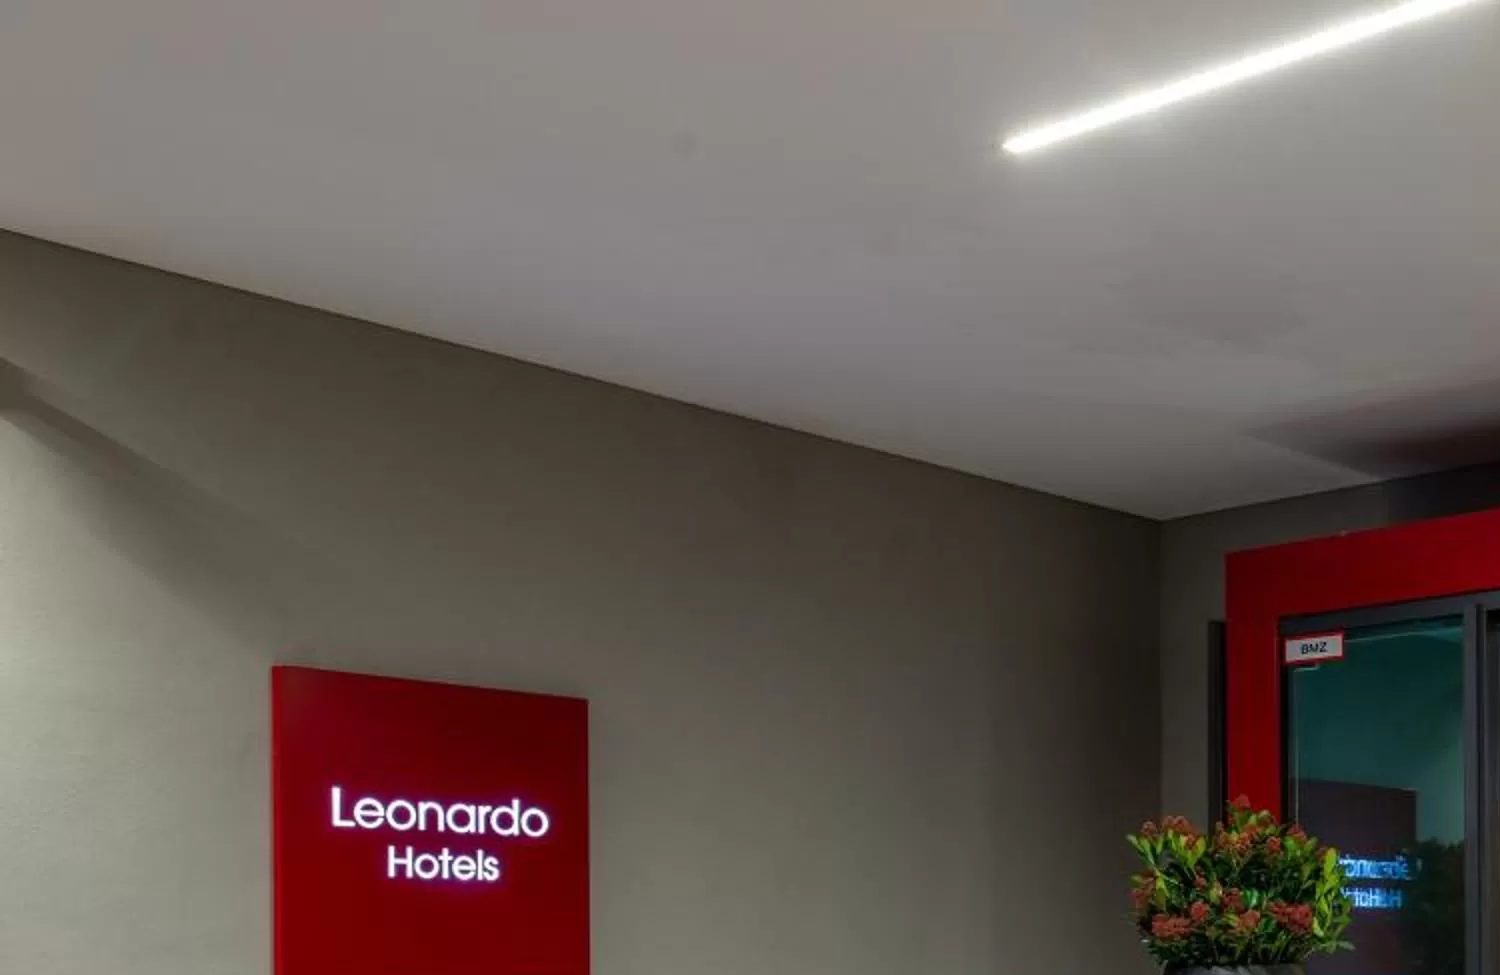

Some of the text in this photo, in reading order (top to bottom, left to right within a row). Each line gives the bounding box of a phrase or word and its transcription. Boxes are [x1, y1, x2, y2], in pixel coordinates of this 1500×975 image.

[1300, 641, 1328, 655] BMZ
[331, 786, 550, 837] Leonardo
[387, 845, 500, 882] Hotels
